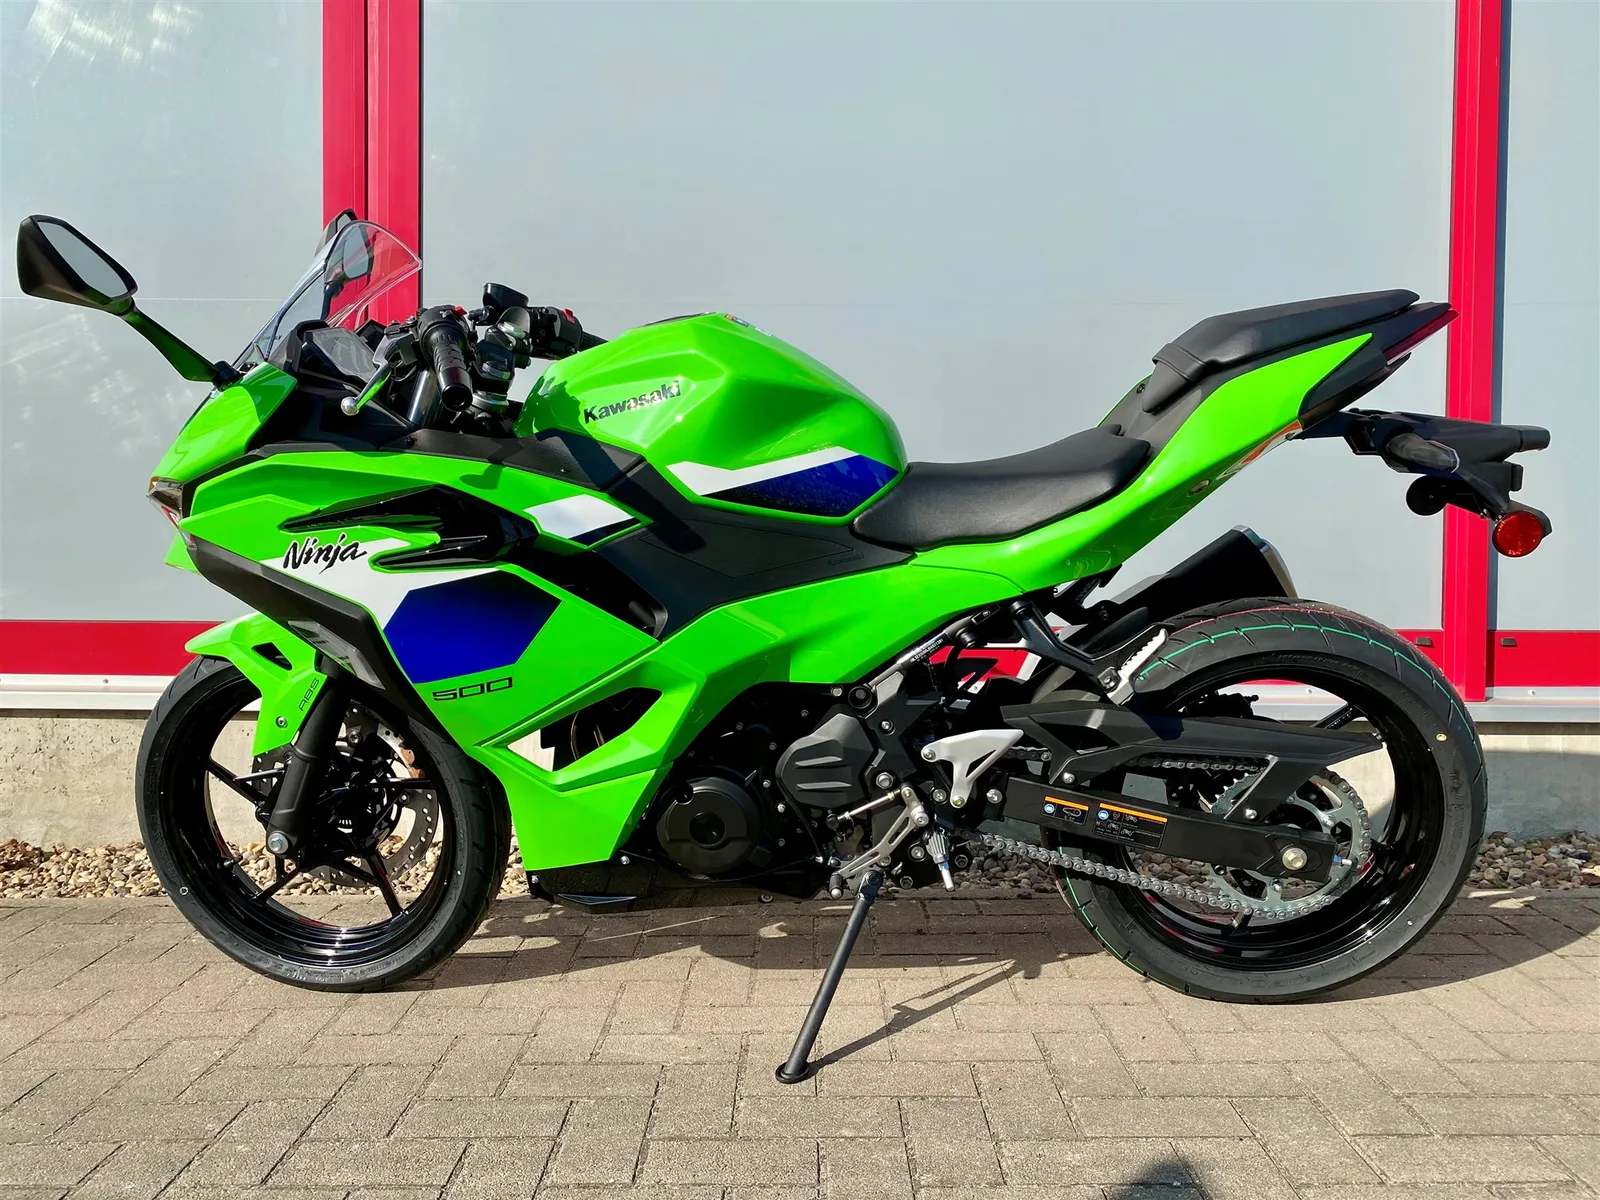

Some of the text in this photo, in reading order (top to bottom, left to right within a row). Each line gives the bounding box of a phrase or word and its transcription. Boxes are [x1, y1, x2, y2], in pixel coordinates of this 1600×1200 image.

[583, 380, 681, 424] Kawasaki
[283, 533, 367, 574] Ninja
[298, 677, 320, 711] ABS
[432, 677, 513, 701] 500
